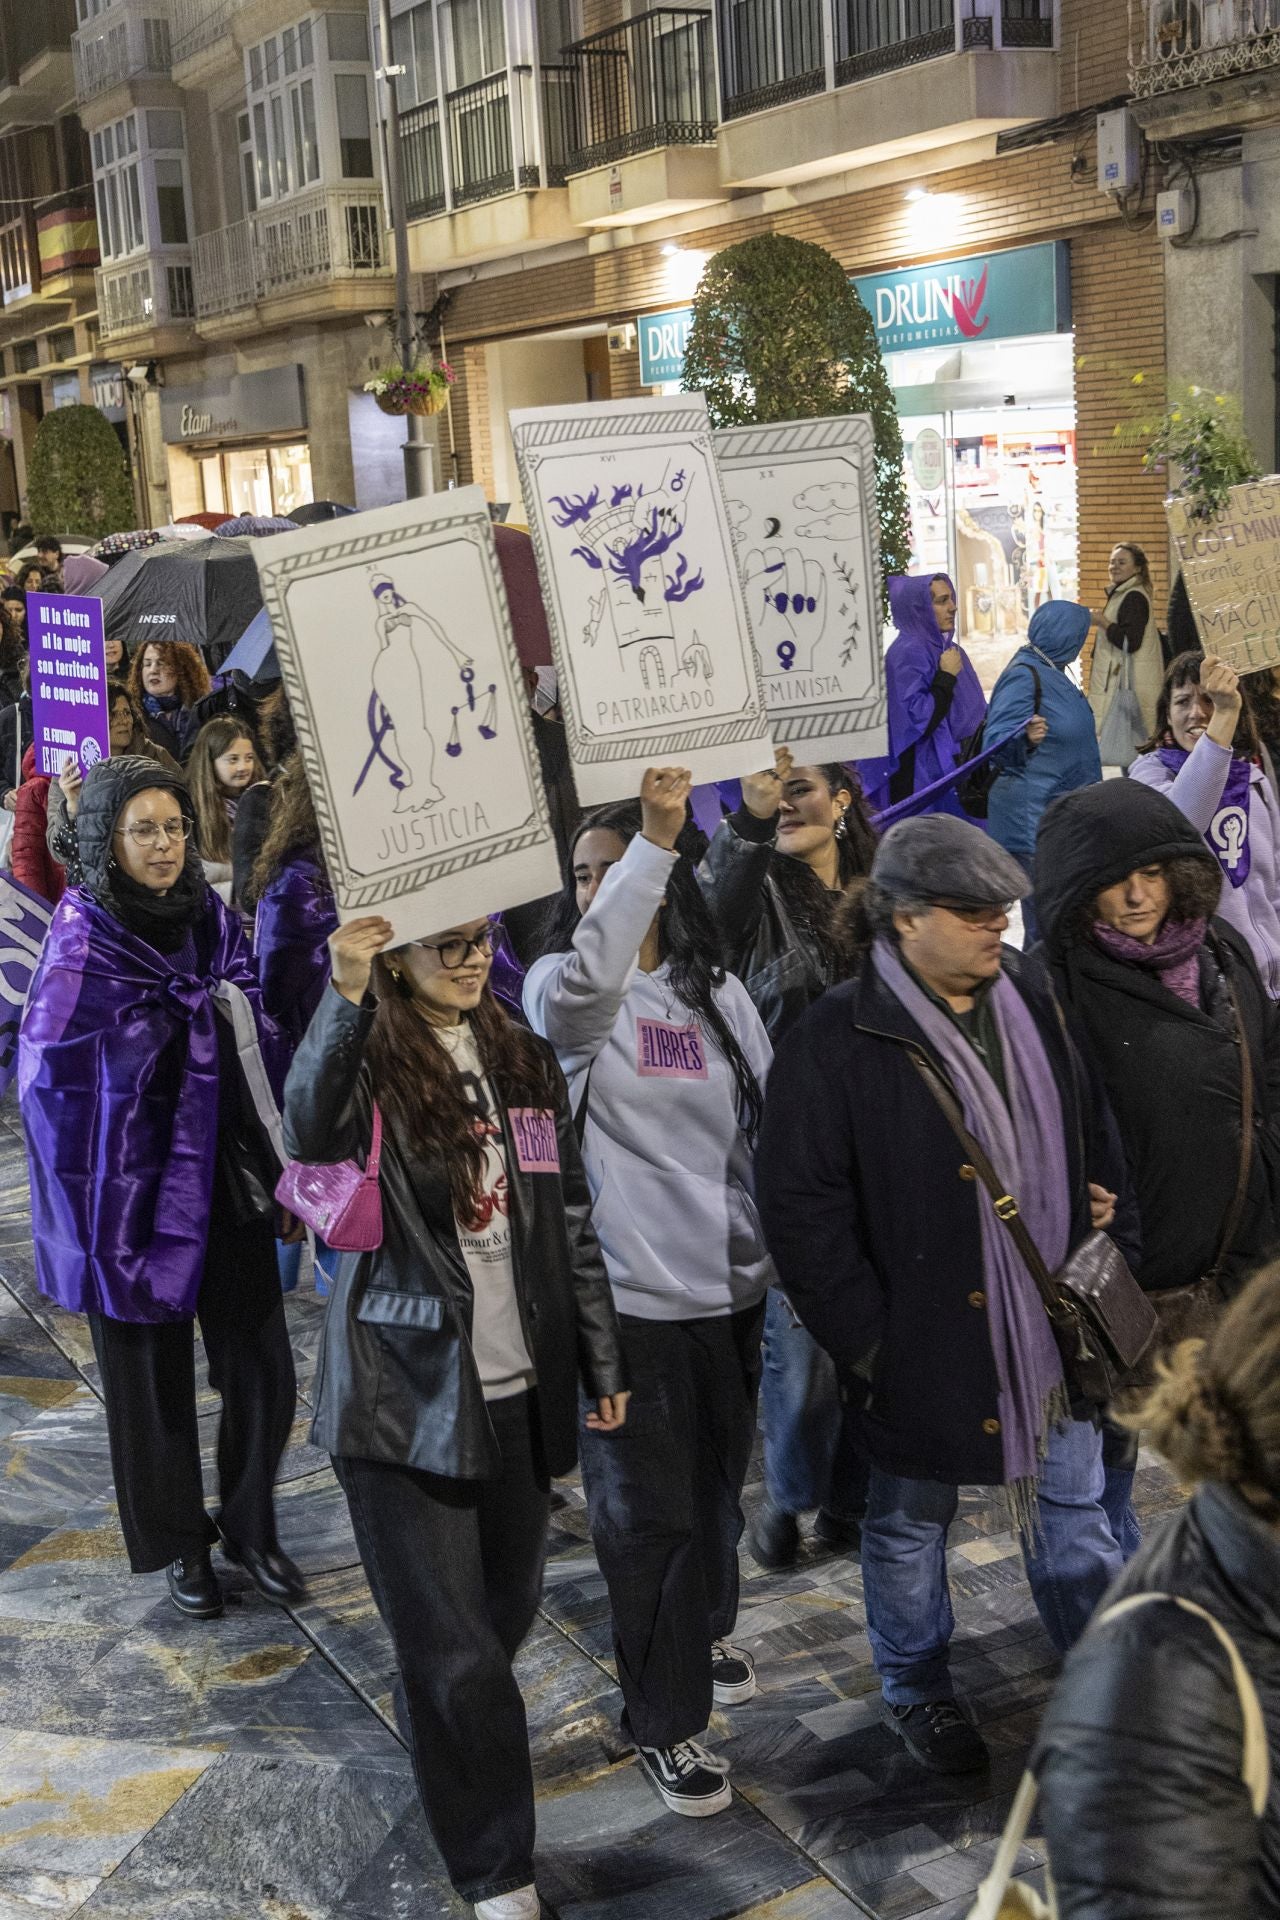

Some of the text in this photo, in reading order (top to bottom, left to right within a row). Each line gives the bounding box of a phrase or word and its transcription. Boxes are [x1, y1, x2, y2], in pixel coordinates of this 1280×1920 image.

[181, 404, 211, 436] Etam
[1253, 556, 1266, 571] a
[40, 606, 90, 628] Ni la tierra
[138, 614, 177, 624] INESIS
[42, 633, 91, 656] ni la mujer
[37, 659, 99, 681] son territorio
[40, 682, 99, 706] de conquista
[596, 689, 714, 726] PATRIARCADO
[43, 726, 51, 742] EL
[42, 746, 51, 774] ES
[377, 801, 490, 860] JUSTICIA
[648, 1025, 702, 1070] LIBRES
